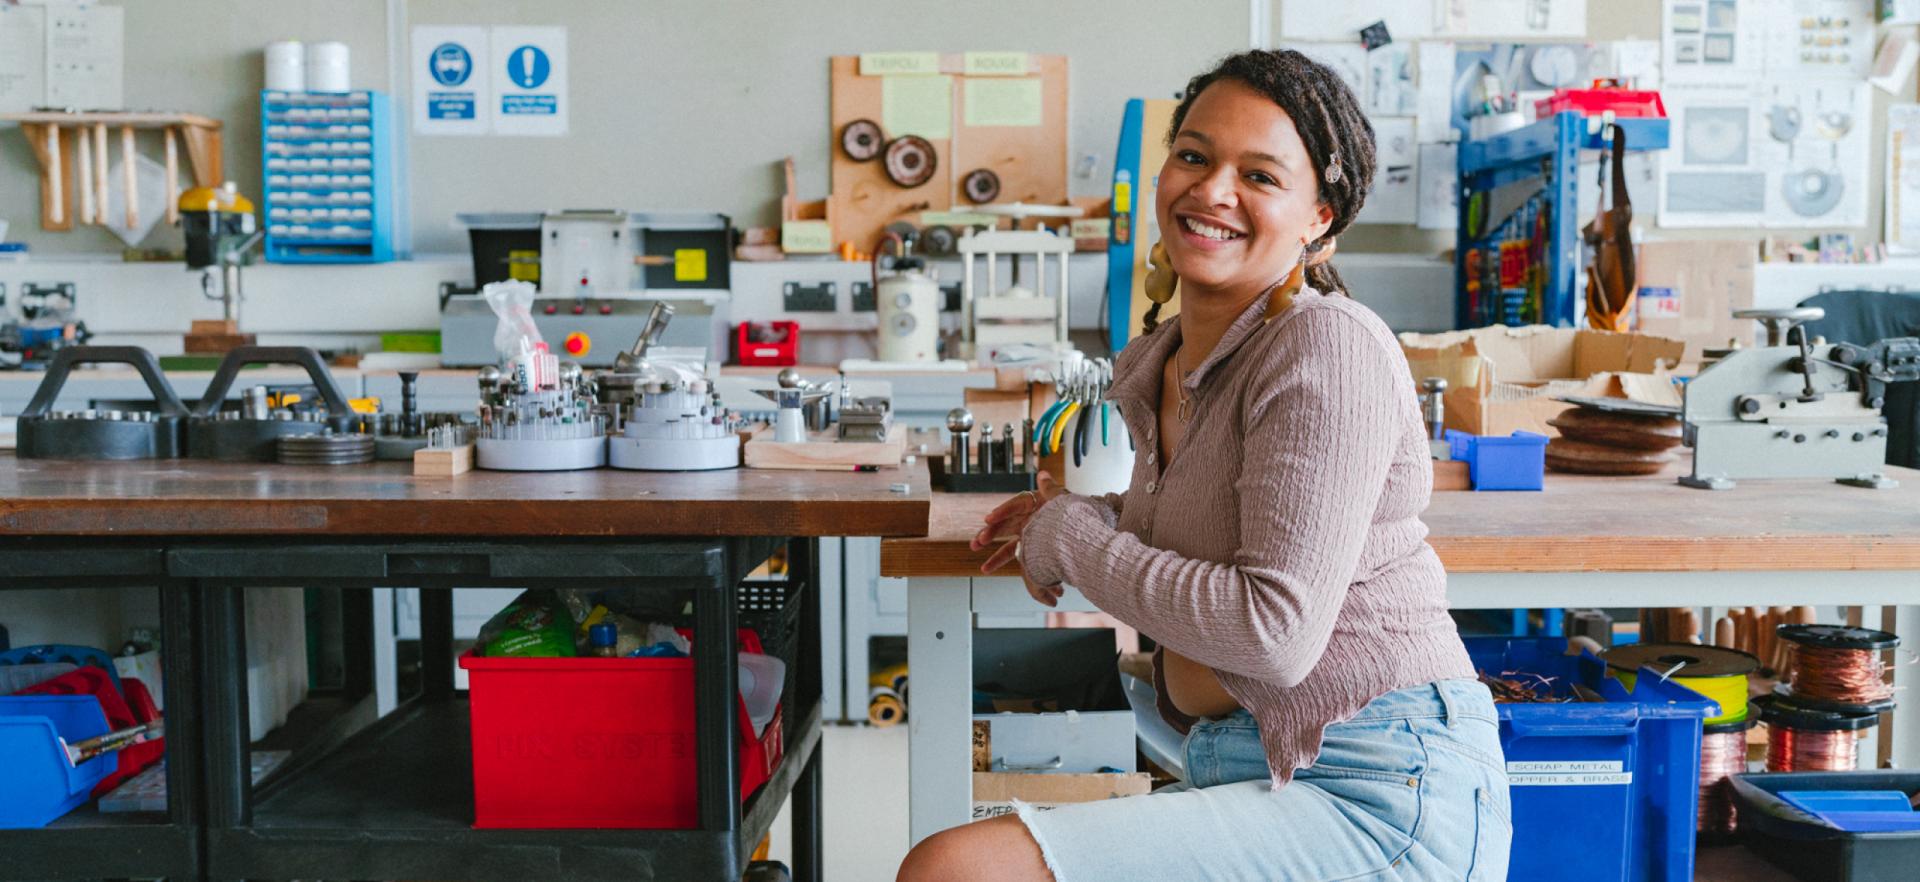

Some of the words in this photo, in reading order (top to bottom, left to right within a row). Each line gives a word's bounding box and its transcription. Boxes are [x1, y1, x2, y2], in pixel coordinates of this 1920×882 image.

[572, 732, 693, 759] SYSTE
[1514, 762, 1563, 771] SCRAP
[1569, 762, 1615, 771] METAL
[1508, 775, 1557, 784] OPPER
[1583, 774, 1629, 783] BRASS
